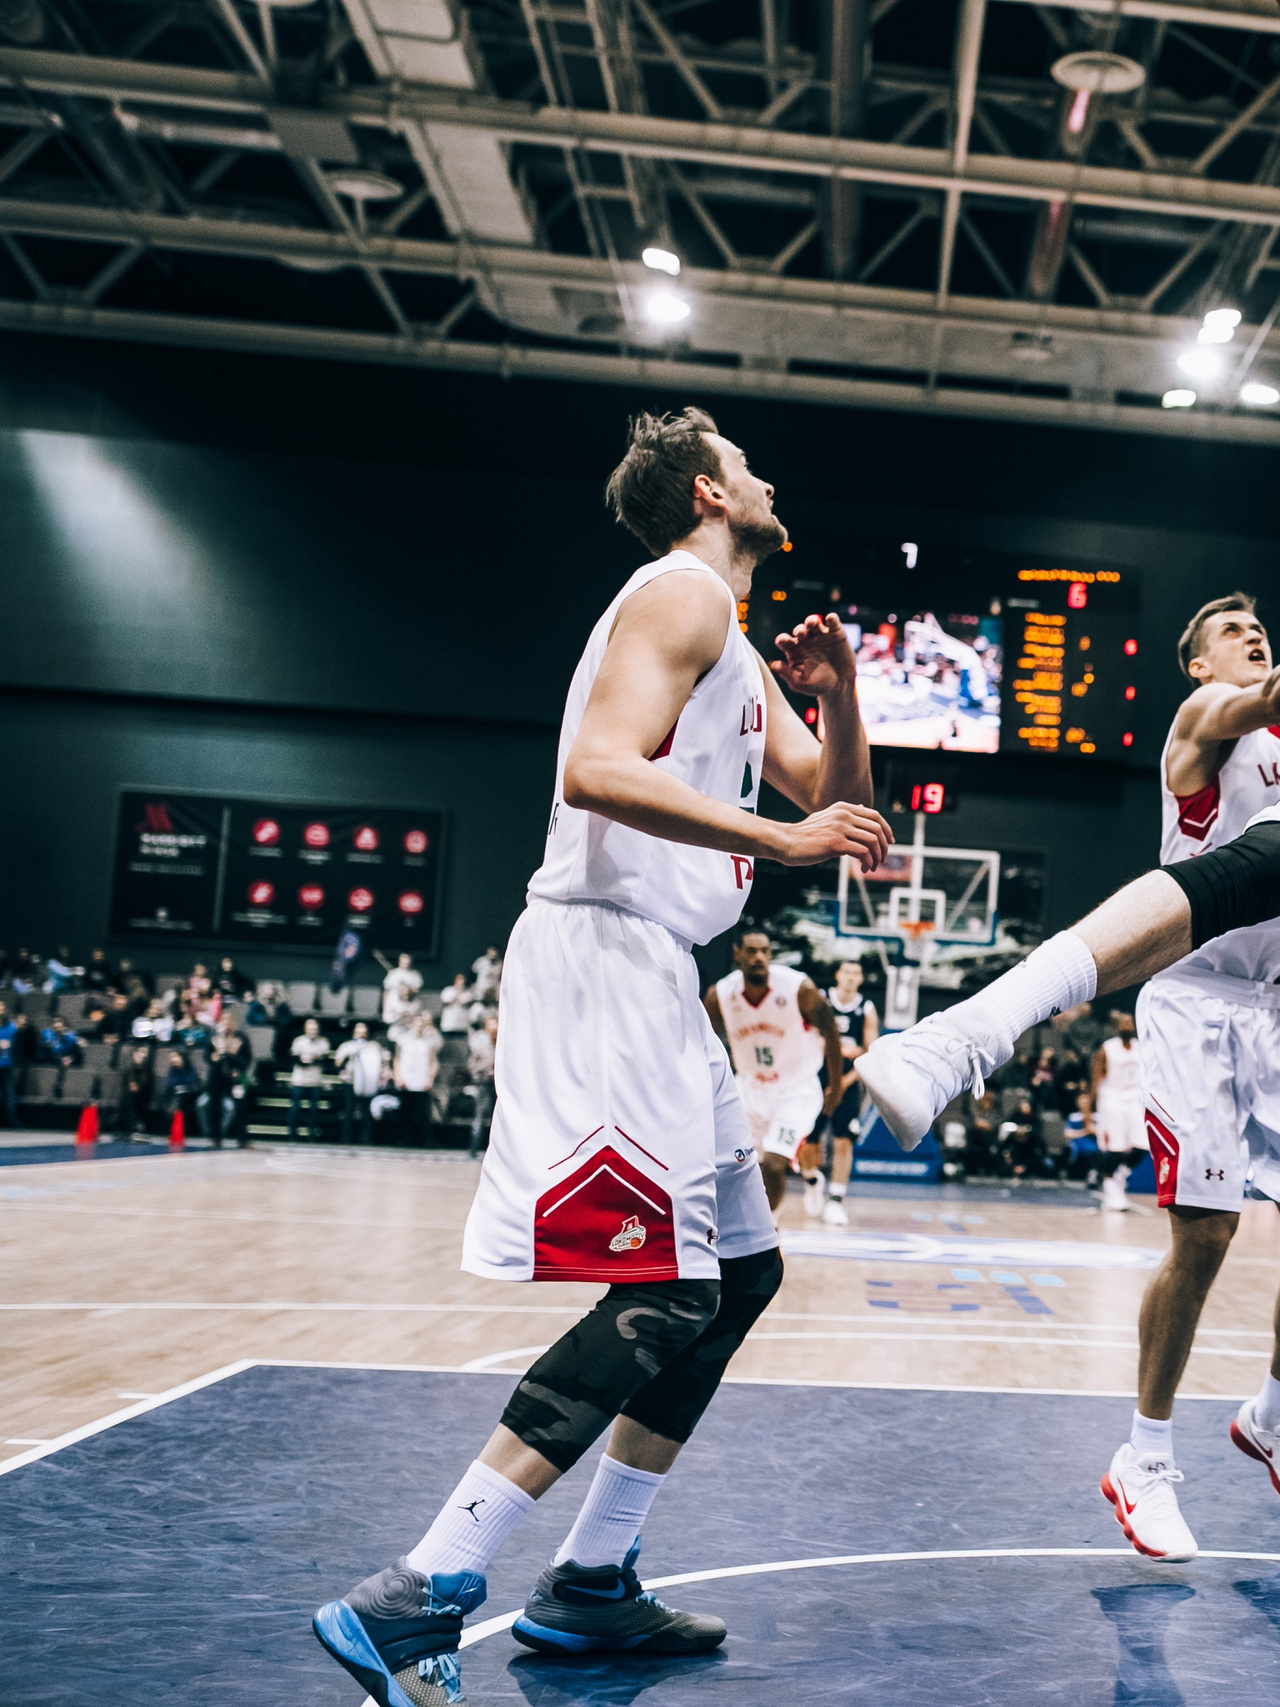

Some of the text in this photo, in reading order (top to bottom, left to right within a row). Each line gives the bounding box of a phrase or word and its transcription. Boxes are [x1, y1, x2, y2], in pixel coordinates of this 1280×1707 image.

[910, 783, 945, 814] 19
[755, 1045, 775, 1068] 15
[777, 1126, 797, 1146] 15
